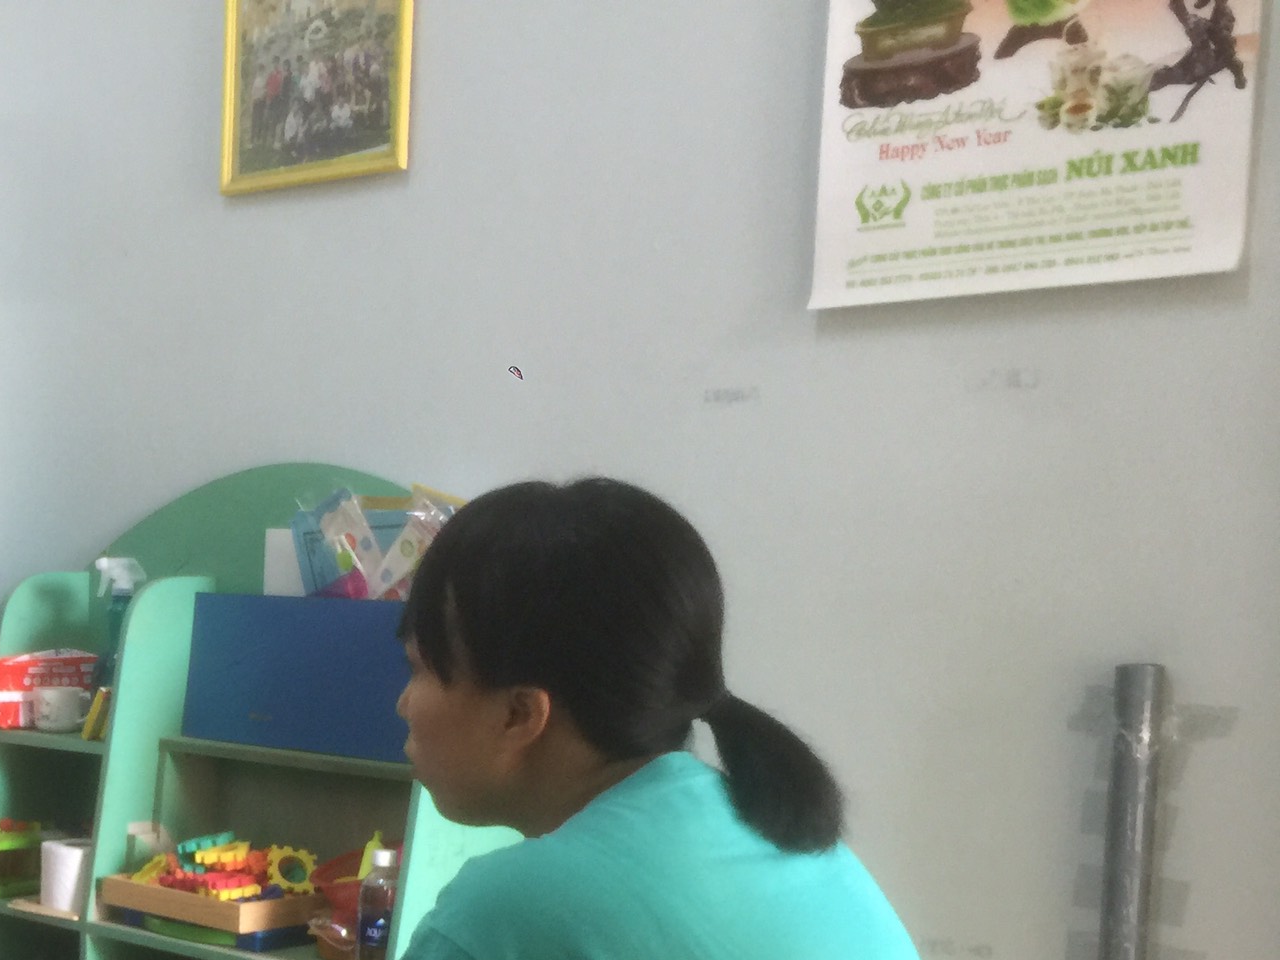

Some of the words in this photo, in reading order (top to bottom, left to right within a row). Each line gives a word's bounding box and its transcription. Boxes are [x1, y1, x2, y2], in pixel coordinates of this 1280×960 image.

[879, 142, 929, 161] Happy
[935, 135, 968, 151] New
[976, 129, 1012, 146] Year
[1066, 150, 1113, 181] NÚI
[1121, 142, 1200, 173] XANH
